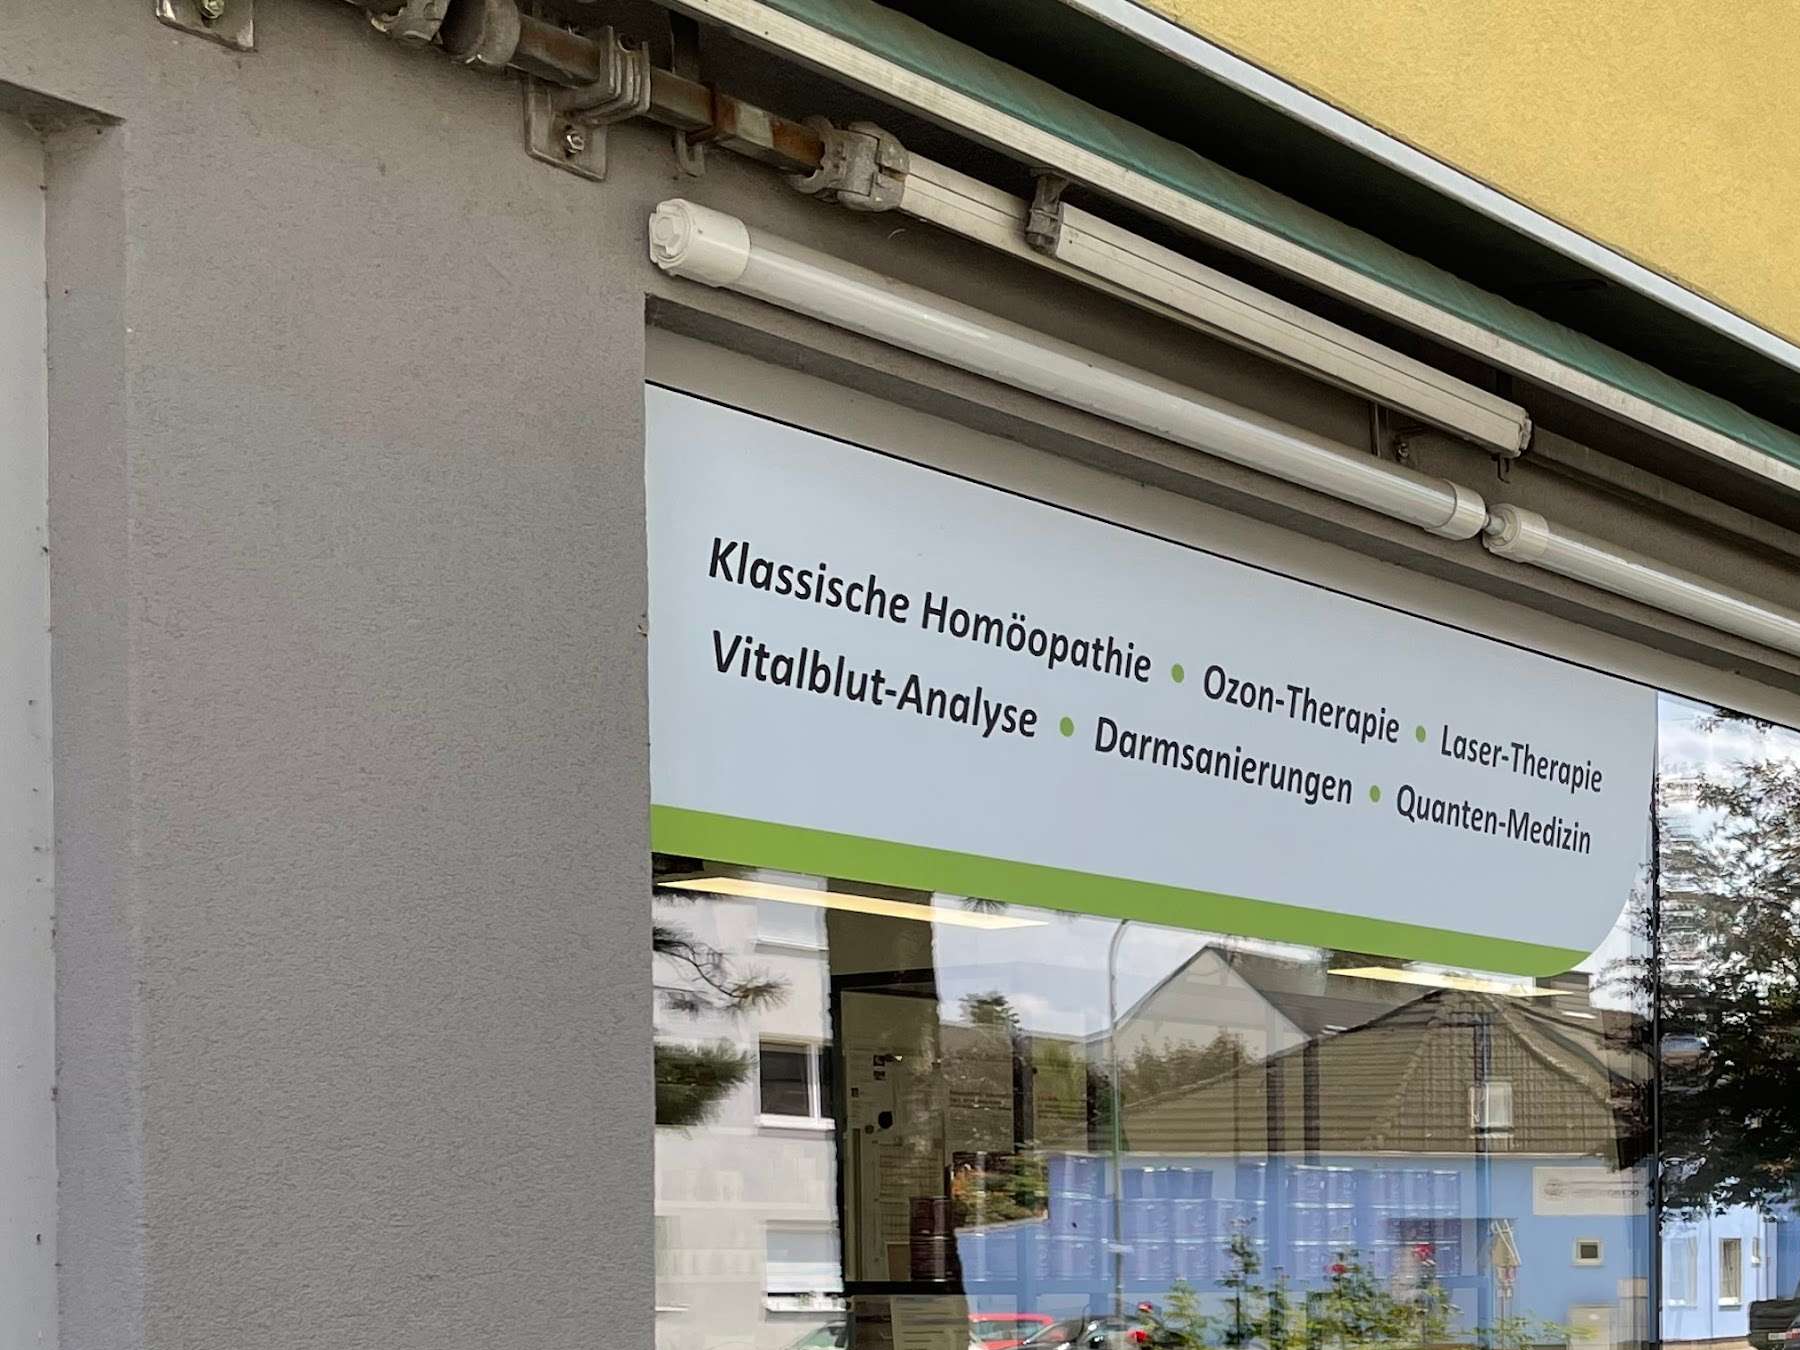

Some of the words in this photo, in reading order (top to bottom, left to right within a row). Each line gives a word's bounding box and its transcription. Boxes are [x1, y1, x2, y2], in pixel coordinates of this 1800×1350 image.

[708, 537, 910, 624] Klassische
[921, 591, 1152, 684] Homöopathie
[1202, 664, 1400, 745] Ozon-Therapie
[1441, 724, 1603, 794] Laser-Therapie
[713, 630, 1038, 738] Vitalblut-Analyse
[1095, 716, 1353, 805] Darmsanierungen
[1396, 784, 1592, 855] Quanten-Medizin
